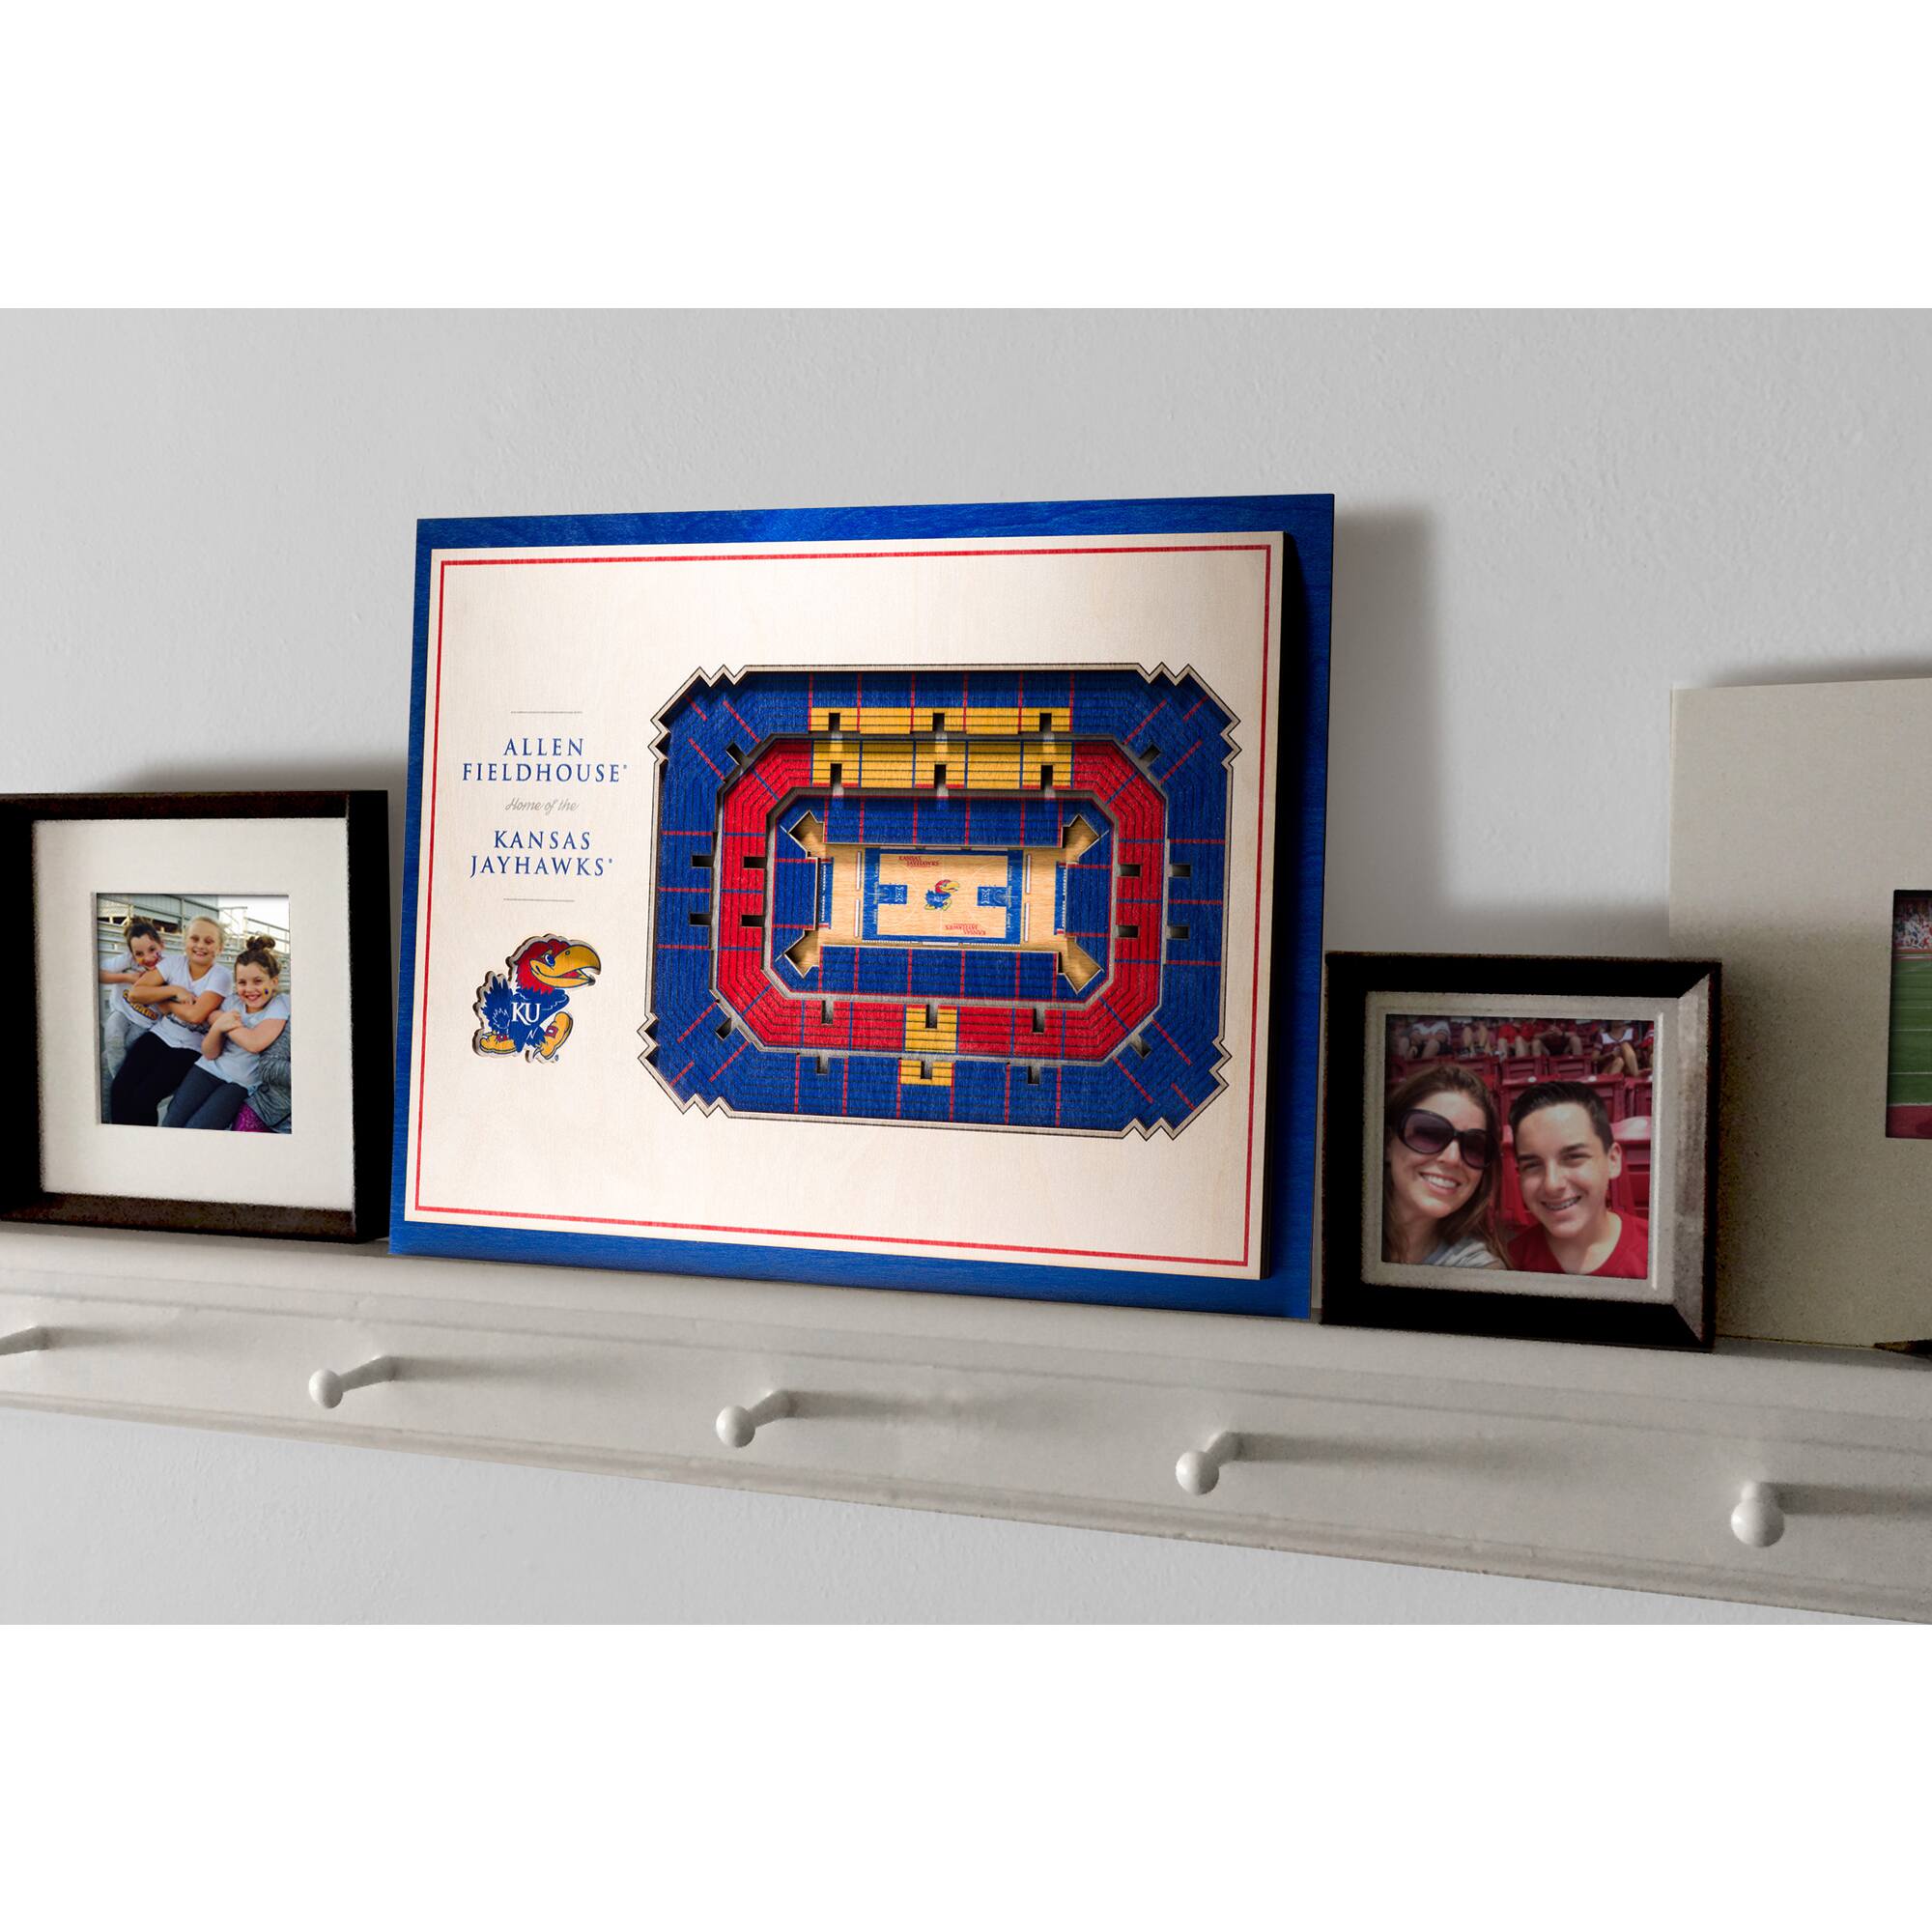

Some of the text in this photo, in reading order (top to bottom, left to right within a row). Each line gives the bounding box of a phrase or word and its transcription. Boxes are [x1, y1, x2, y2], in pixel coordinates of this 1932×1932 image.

[503, 737, 583, 756] ALLEN
[504, 797, 580, 815] Home of the
[494, 829, 591, 850] KANSAS
[511, 1002, 541, 1025] KU
